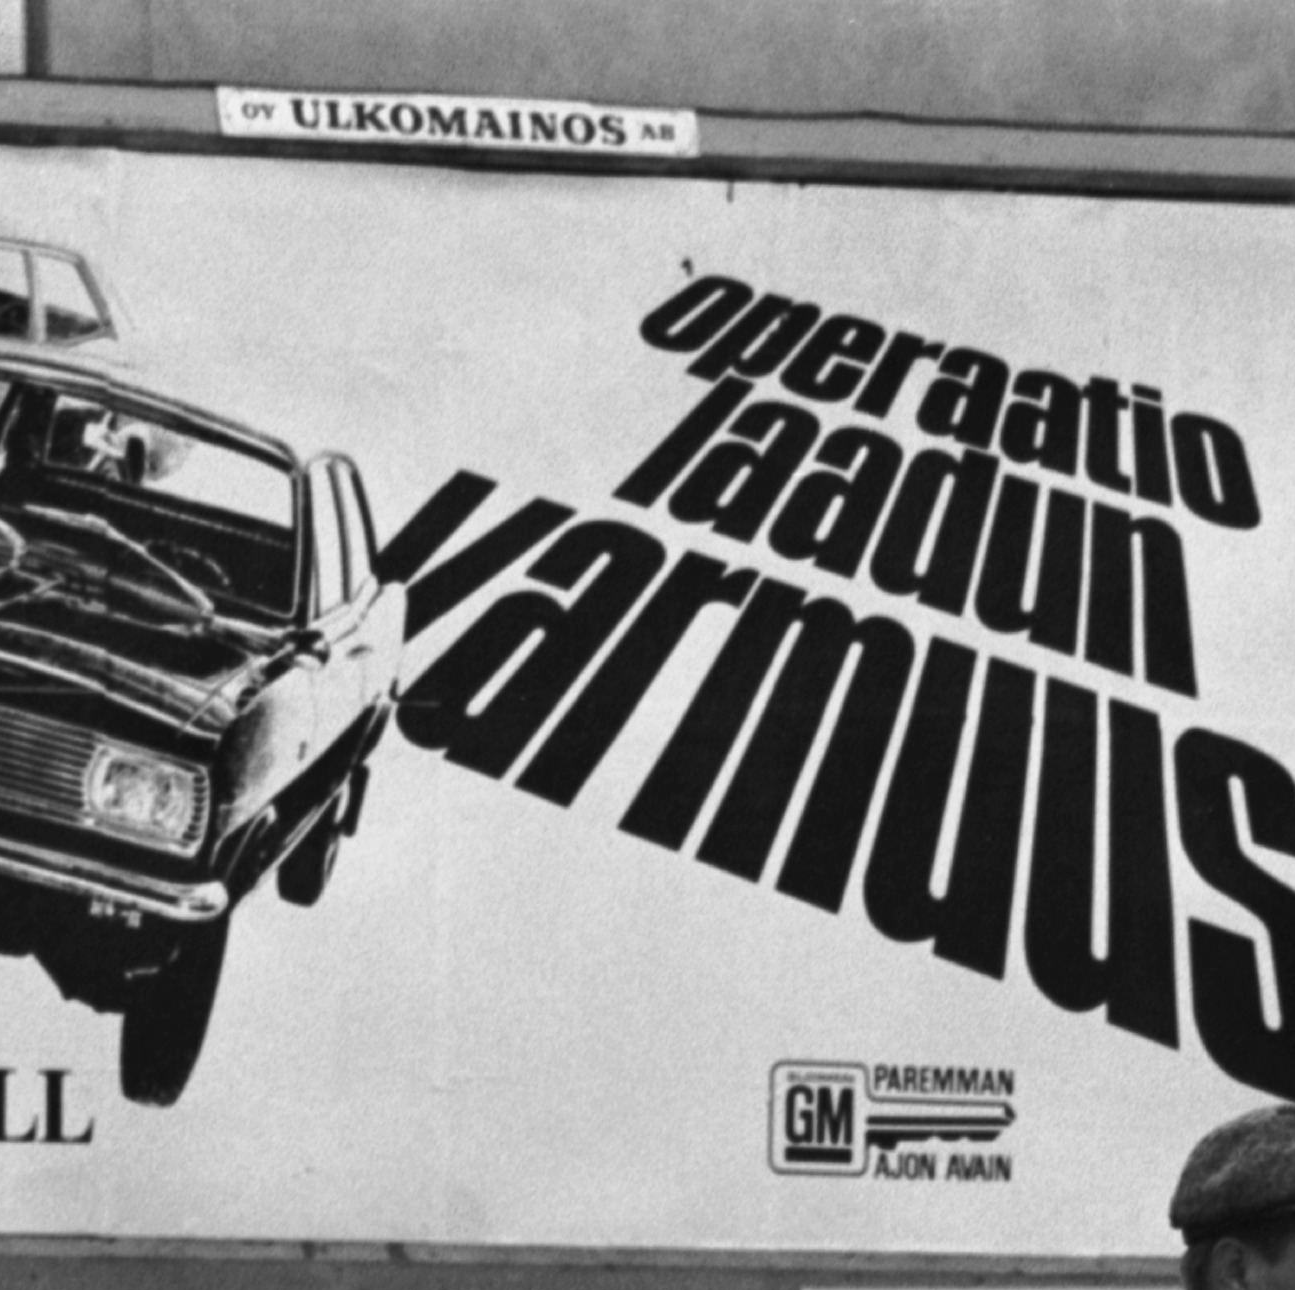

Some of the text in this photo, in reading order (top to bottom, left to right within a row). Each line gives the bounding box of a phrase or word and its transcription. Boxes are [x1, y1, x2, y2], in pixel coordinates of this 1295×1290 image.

[241, 98, 676, 146] OY ULKOMAINOS AB
[638, 274, 1262, 531] operaatio
[610, 374, 1200, 700] laadun
[873, 1063, 1015, 1096] PAREMMAN
[784, 1083, 855, 1146] GM
[873, 1152, 1012, 1182] AJON AVAIN
